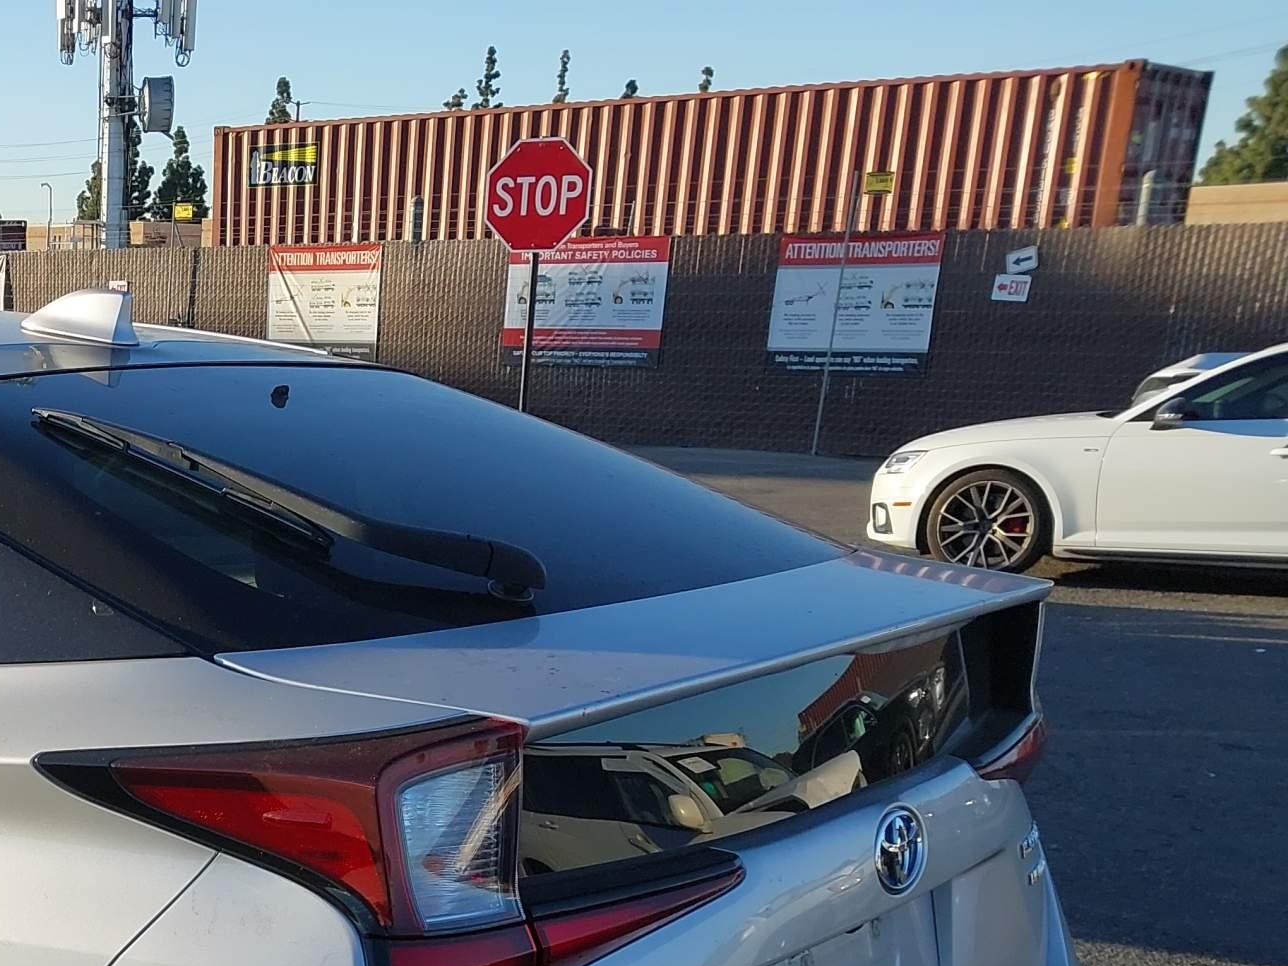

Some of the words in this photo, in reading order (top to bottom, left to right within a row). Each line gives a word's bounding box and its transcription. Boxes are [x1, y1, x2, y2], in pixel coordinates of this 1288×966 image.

[493, 175, 583, 217] STOP
[521, 251, 573, 261] IMORTANT
[575, 250, 609, 260] SAFETY
[611, 249, 657, 259] POLICIES
[848, 240, 940, 258] TRANSPORTERS!
